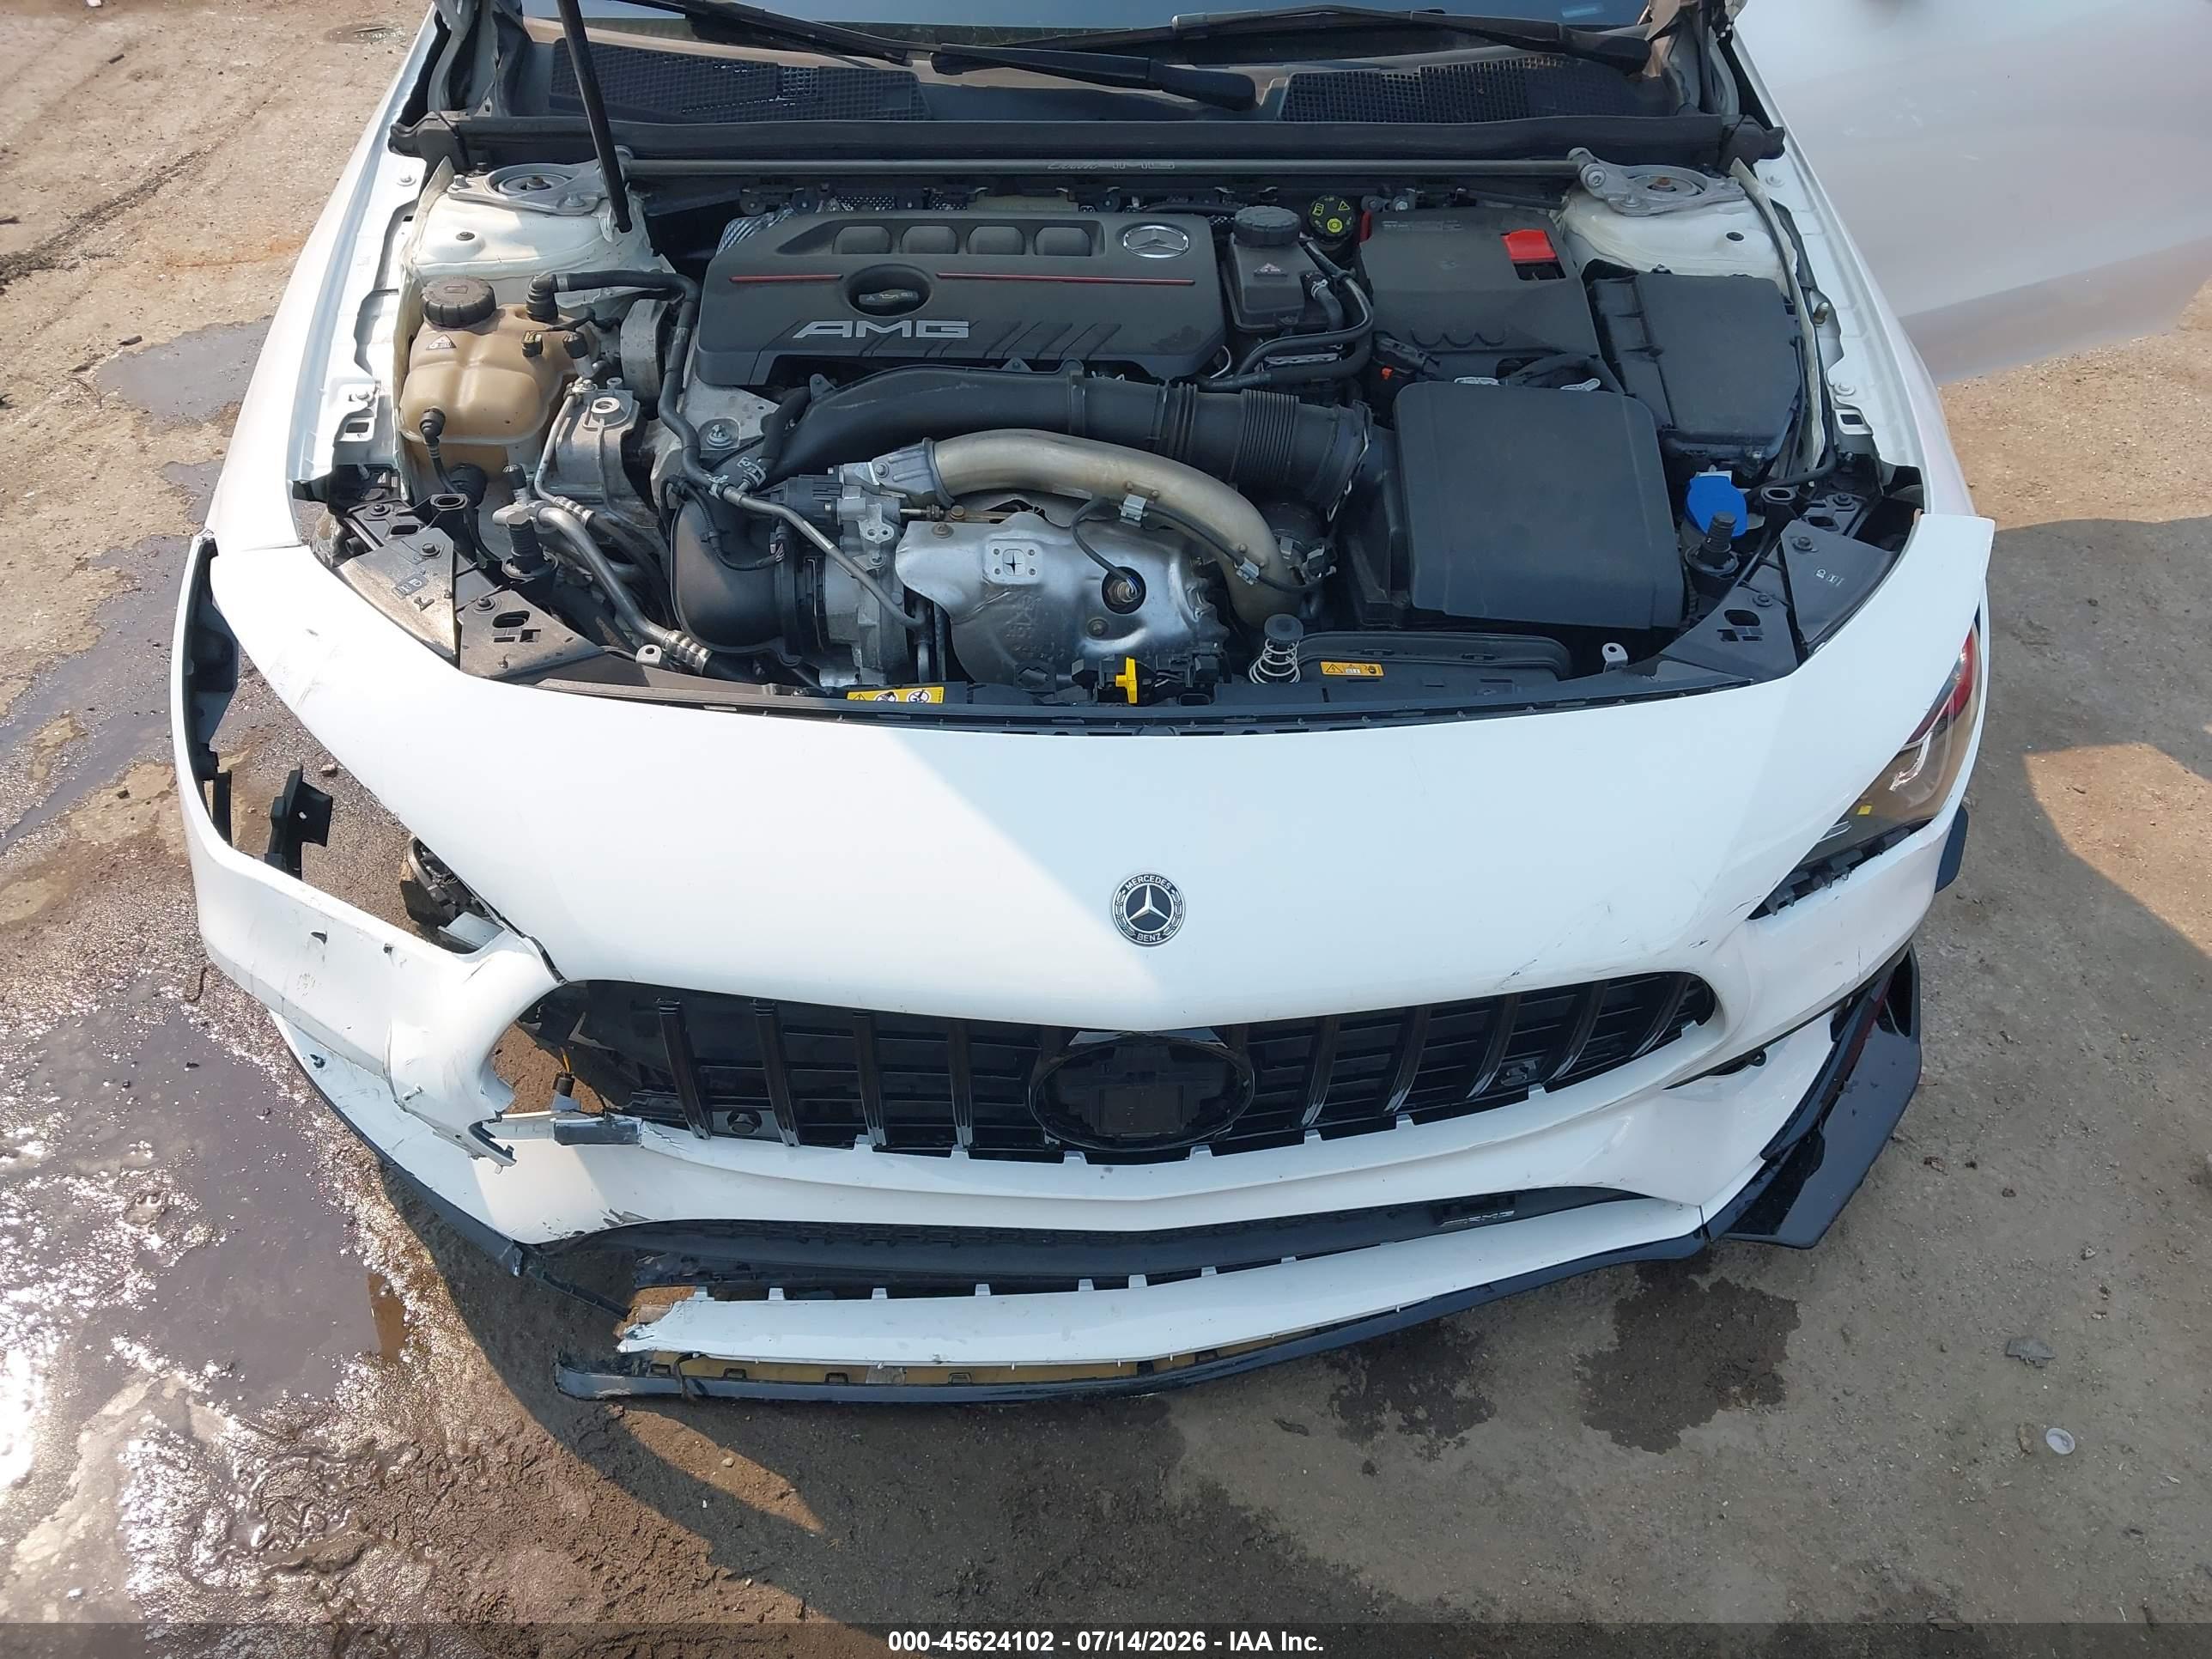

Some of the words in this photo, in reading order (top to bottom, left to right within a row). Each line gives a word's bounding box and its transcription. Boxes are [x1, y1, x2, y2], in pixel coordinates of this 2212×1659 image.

[793, 320, 969, 338] AMG
[1125, 875, 1172, 890] MERCEDES
[1137, 933, 1163, 942] BENZ
